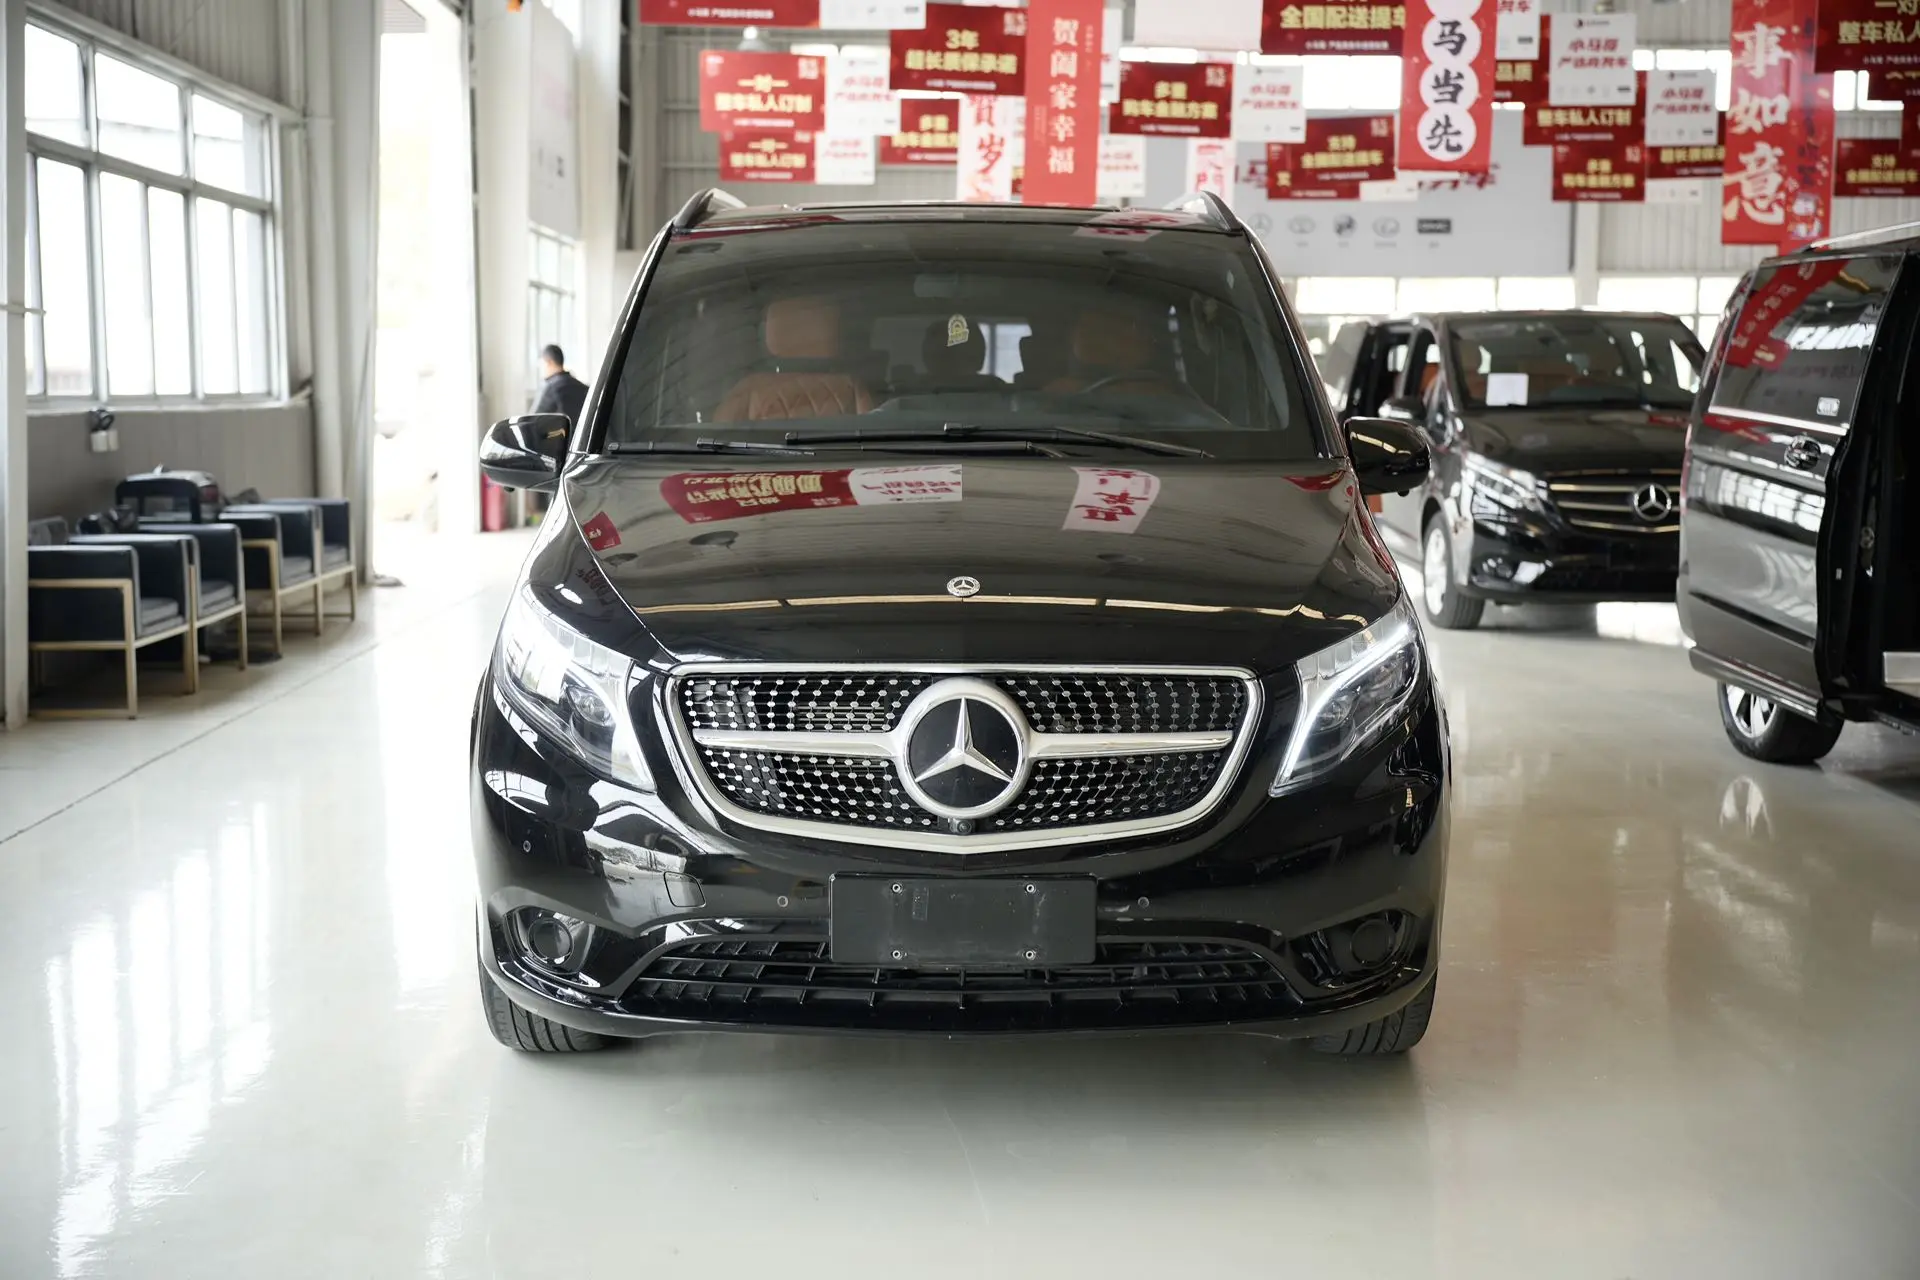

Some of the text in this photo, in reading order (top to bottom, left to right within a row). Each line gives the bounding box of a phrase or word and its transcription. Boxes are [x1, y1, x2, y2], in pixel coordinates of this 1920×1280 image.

[945, 28, 980, 49] 3年
[1426, 20, 1468, 153] 马当先
[1722, 21, 1795, 226] 事如意
